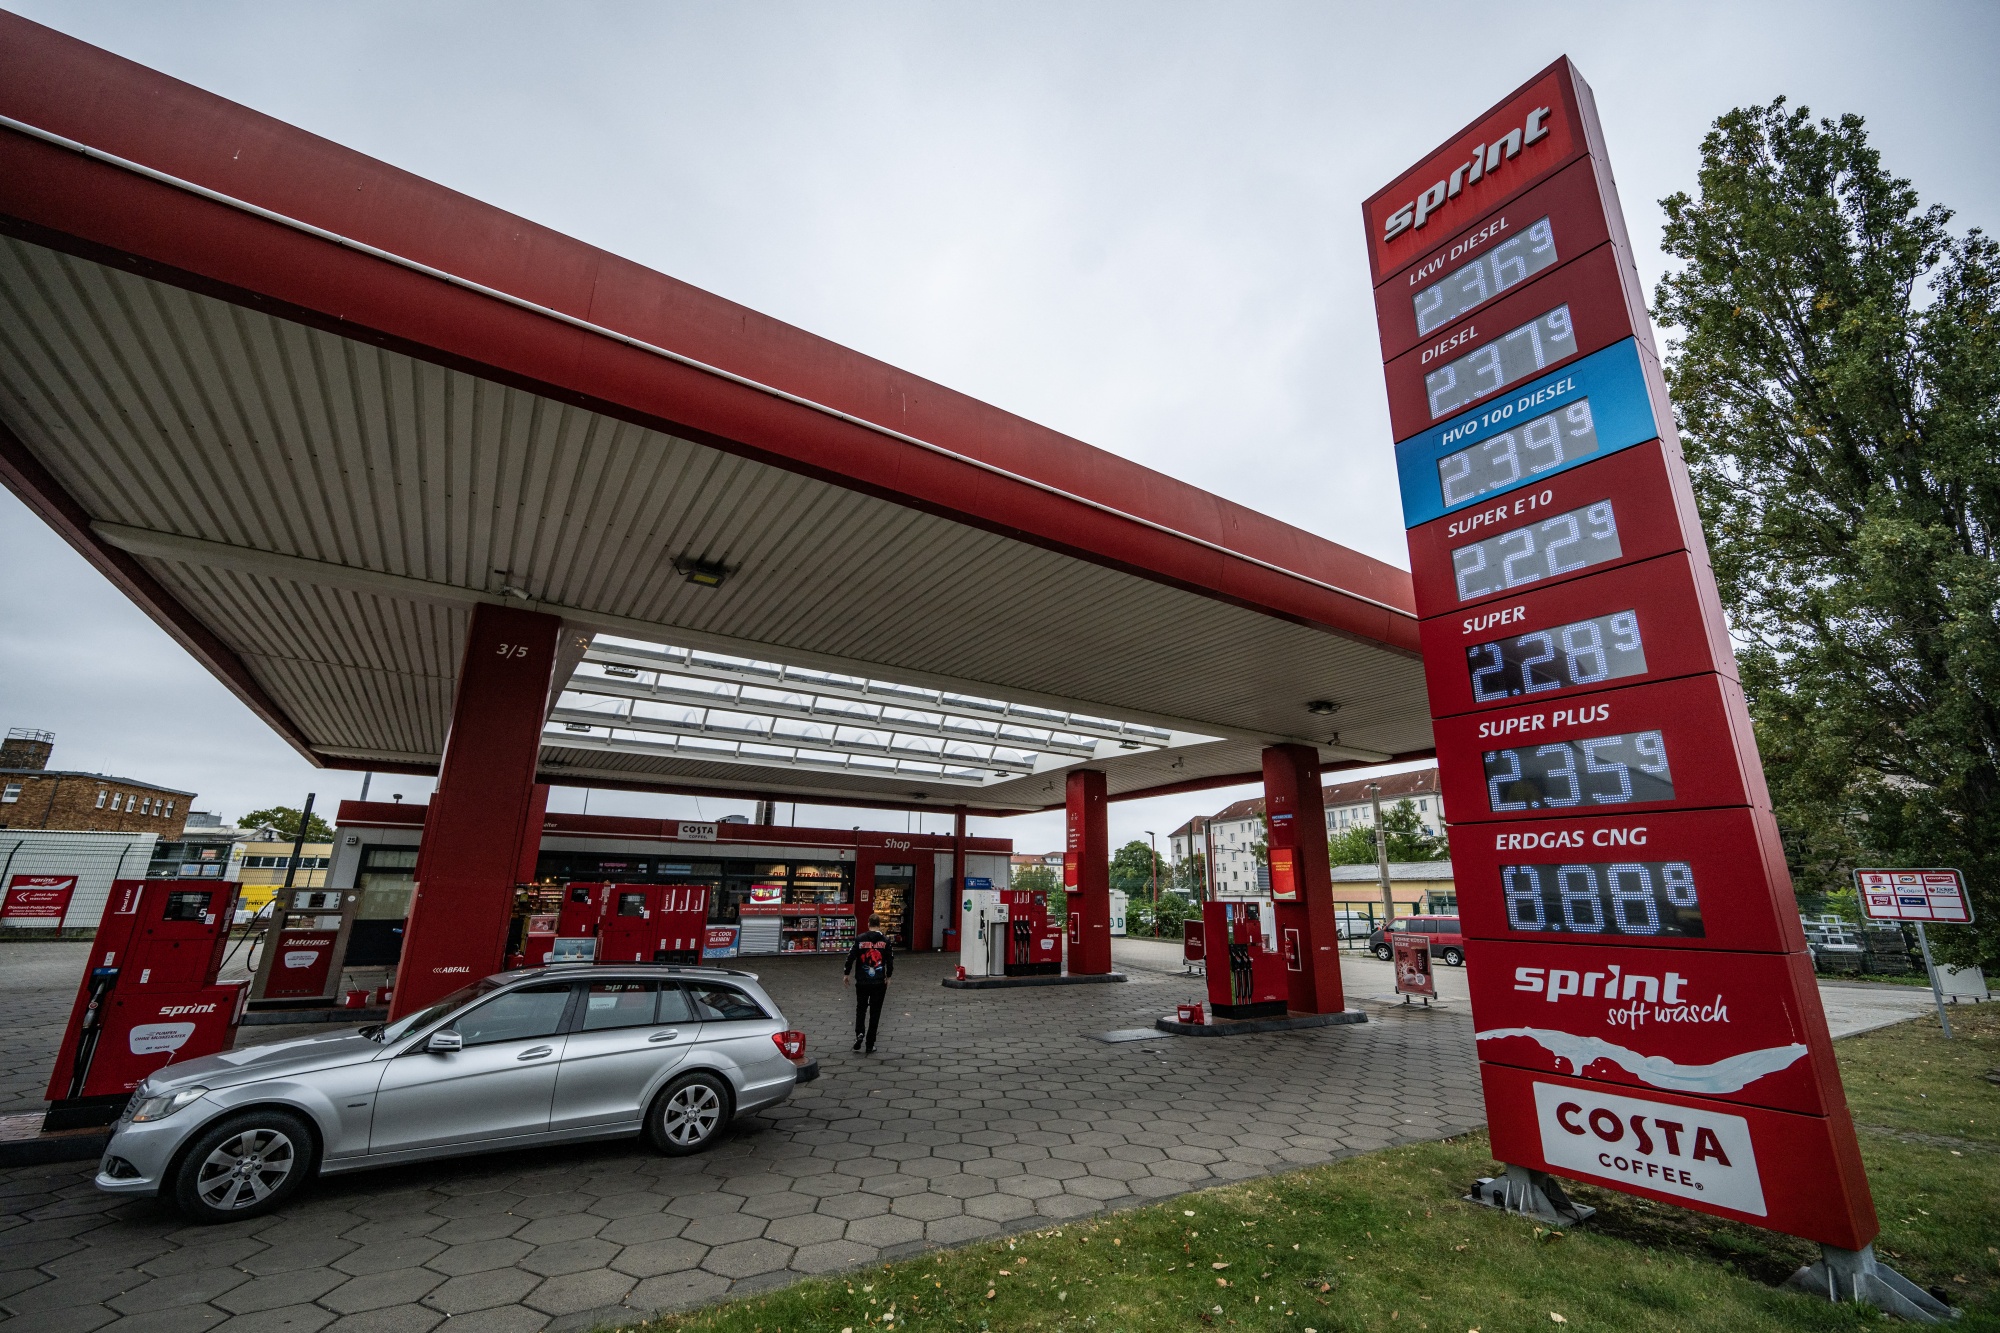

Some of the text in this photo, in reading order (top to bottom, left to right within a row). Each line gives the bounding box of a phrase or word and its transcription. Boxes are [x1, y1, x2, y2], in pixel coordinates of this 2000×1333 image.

[1383, 105, 1551, 243] sprint
[1409, 216, 1509, 286] LKW DIESEL
[1421, 325, 1478, 365] DIESEL
[1442, 377, 1576, 446] HVO 100 DIESEL
[1448, 489, 1553, 538] SUPER E10
[1462, 606, 1526, 635] SUPER
[496, 643, 528, 659] 3/5
[1478, 704, 1610, 738] SUPER PLUS
[682, 825, 714, 834] COSTA
[1496, 827, 1647, 850] ERDGAS CNG
[884, 838, 910, 851] Shop
[198, 908, 208, 917] 5
[639, 906, 645, 914] 3
[283, 938, 331, 947] Autogas
[442, 966, 470, 974] ABFALL
[1514, 964, 1688, 1005] sprint
[159, 1002, 217, 1018] sprint
[1556, 1101, 1733, 1168] COSTA
